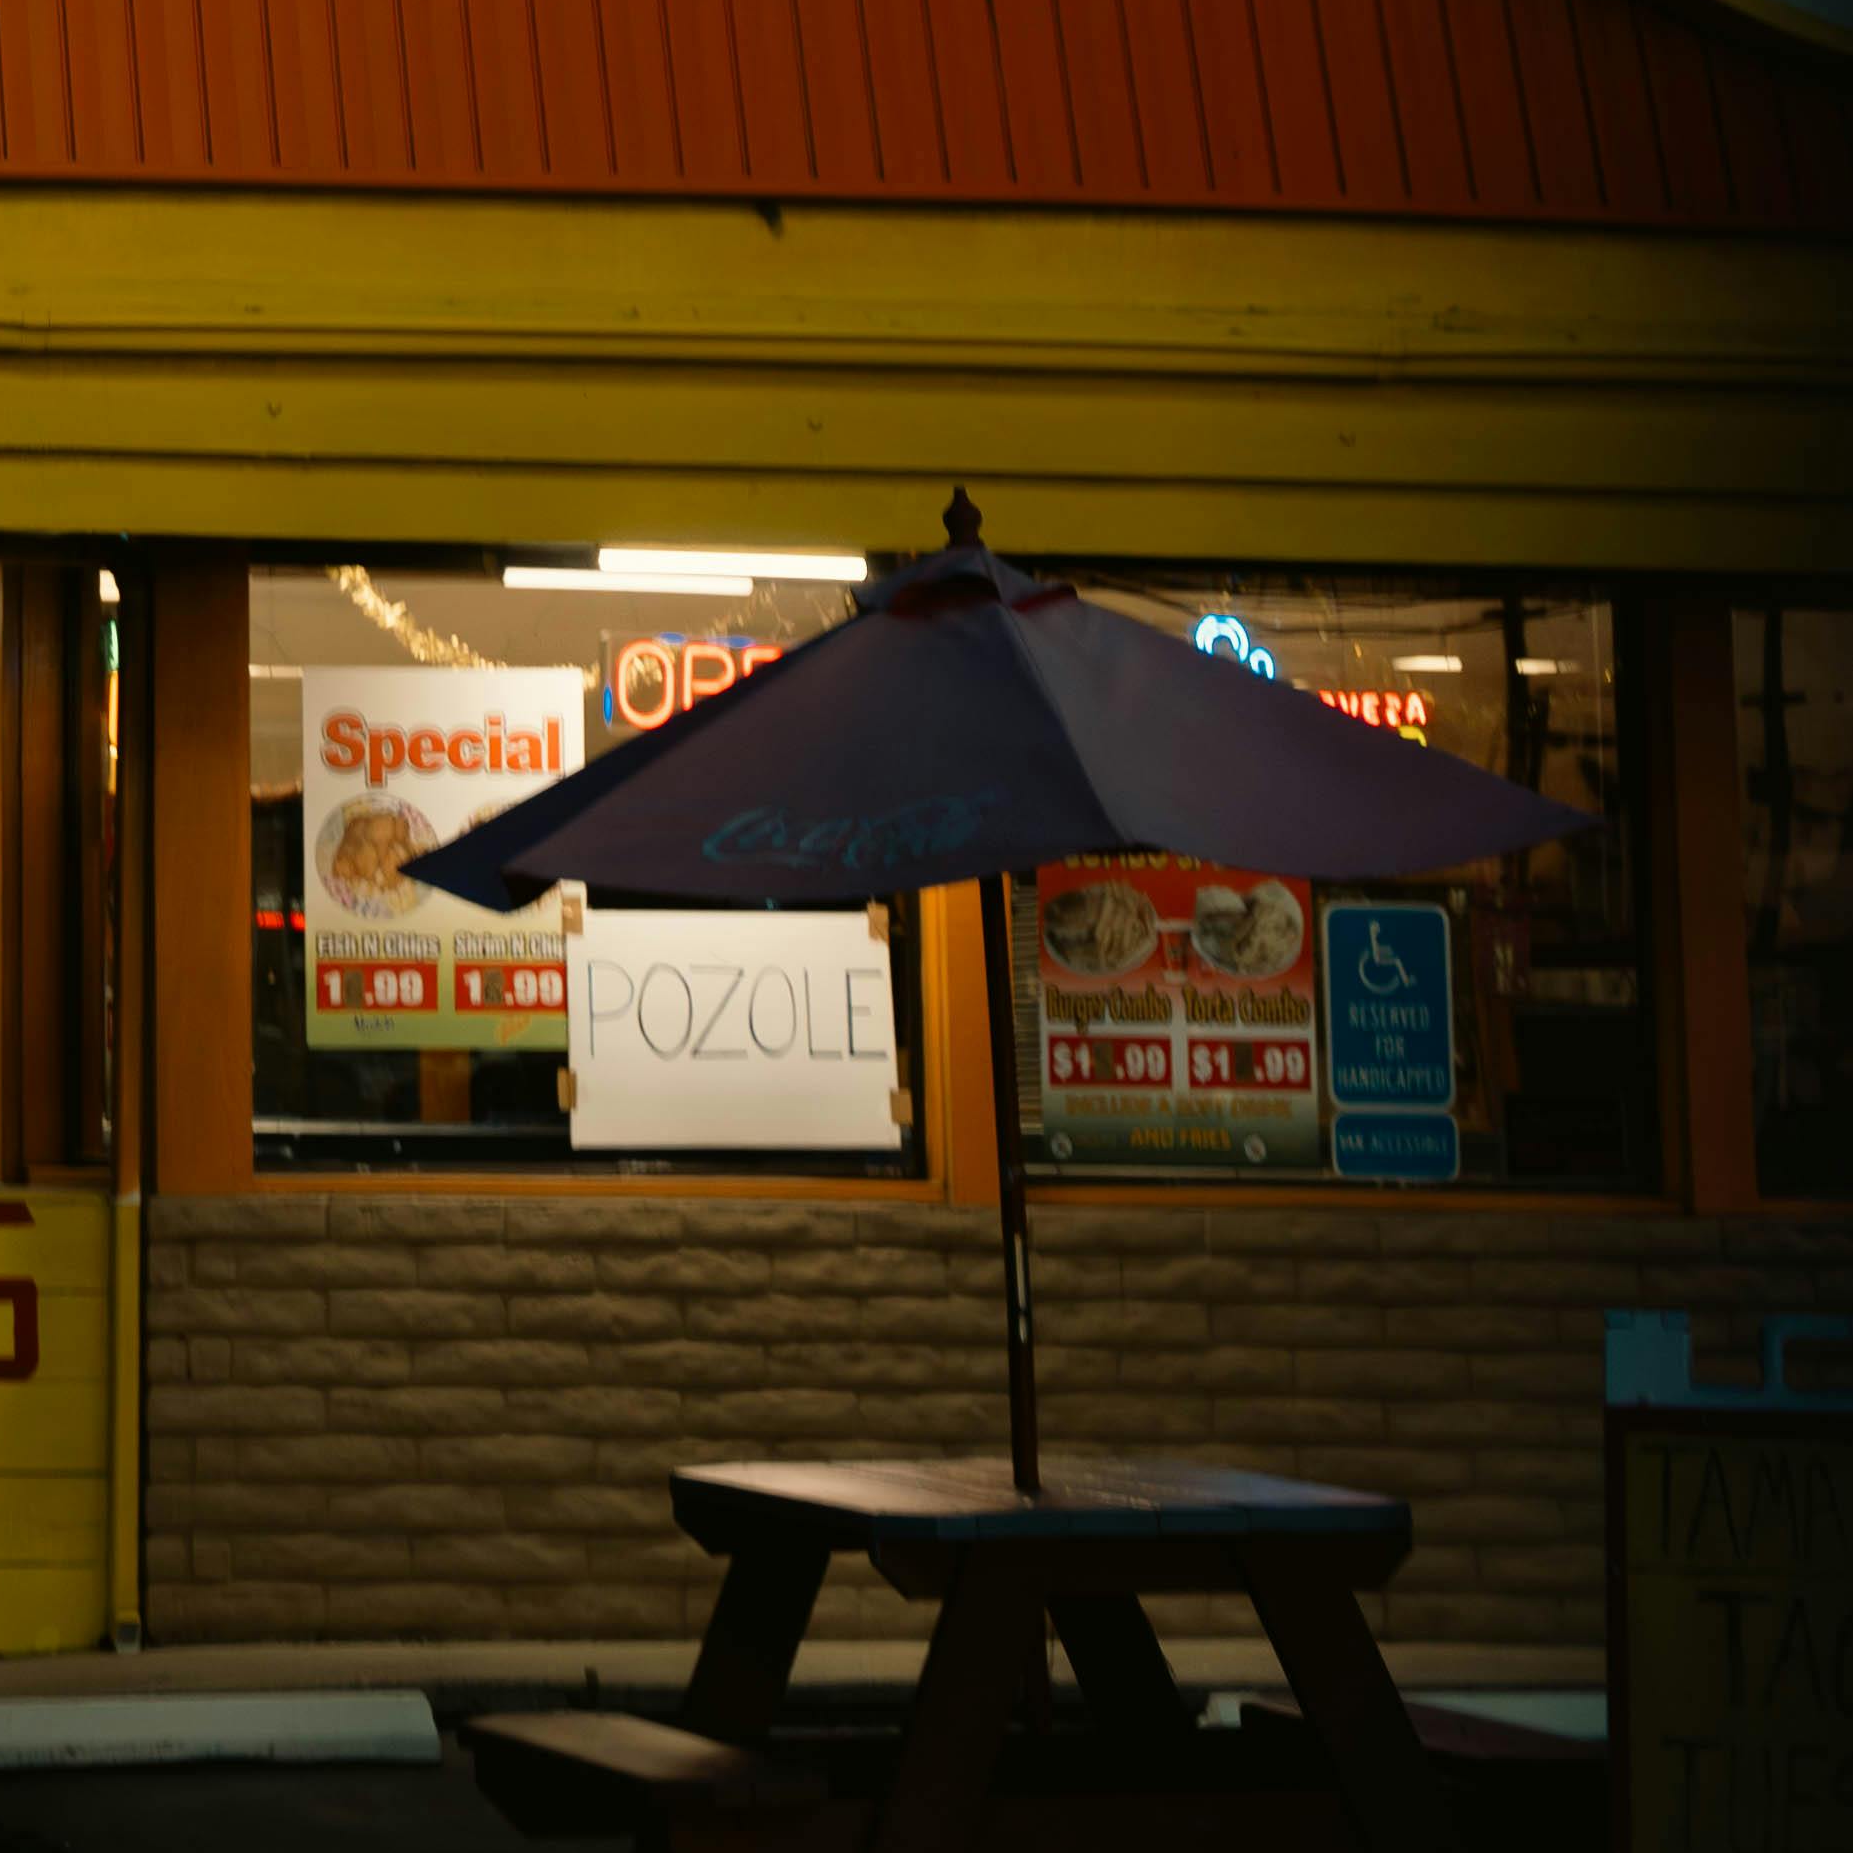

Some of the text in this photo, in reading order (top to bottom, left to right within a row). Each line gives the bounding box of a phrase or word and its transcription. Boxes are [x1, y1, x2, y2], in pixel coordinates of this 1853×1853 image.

[320, 708, 565, 788] Special
[322, 969, 425, 1007] 1.99
[463, 969, 566, 1007] 1.99
[585, 958, 889, 1061] POZOLE
